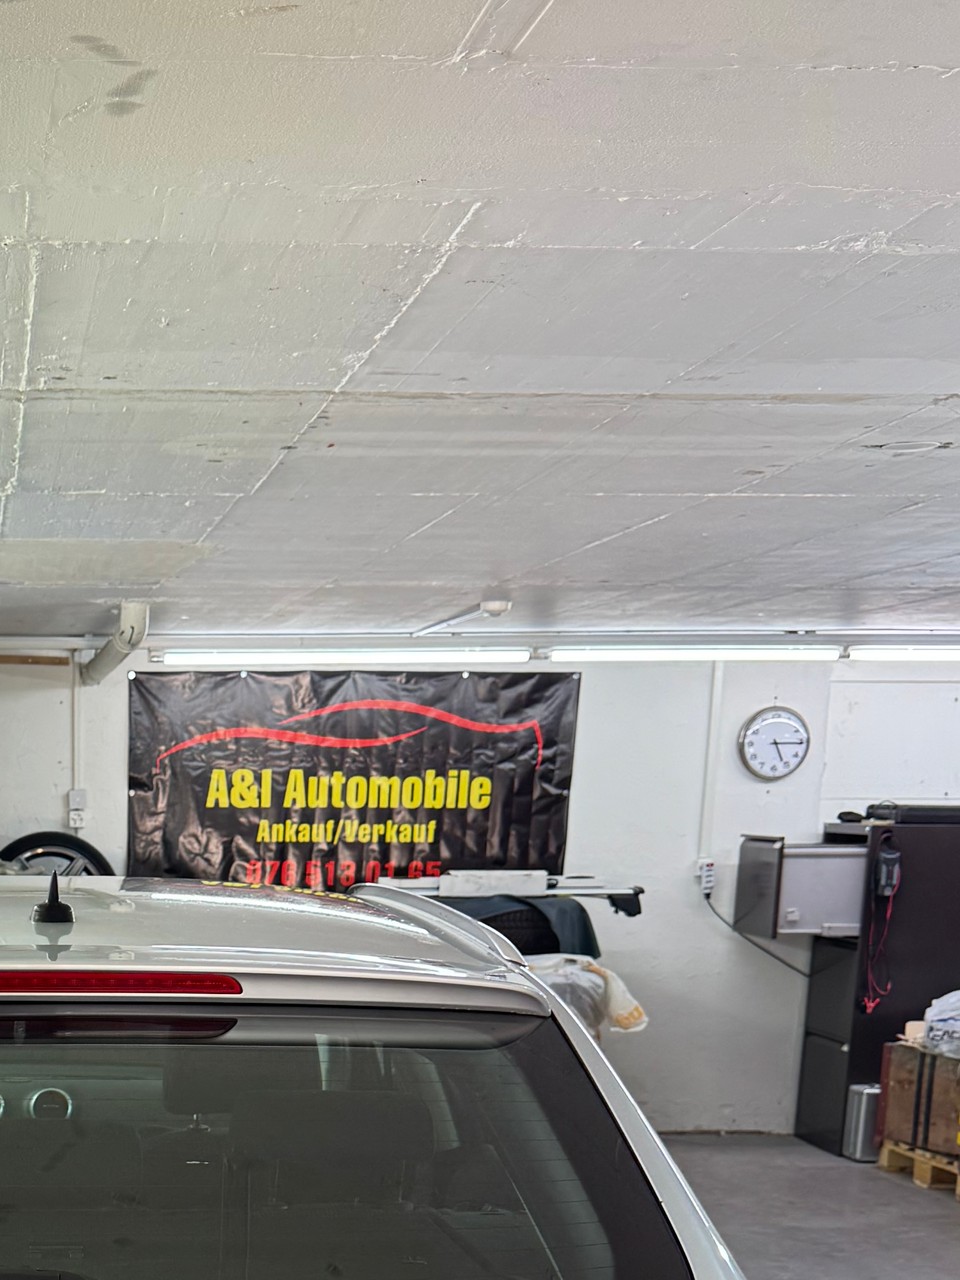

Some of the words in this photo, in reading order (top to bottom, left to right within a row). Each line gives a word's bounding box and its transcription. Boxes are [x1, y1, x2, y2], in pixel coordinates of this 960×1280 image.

[205, 768, 273, 809] A&I
[283, 769, 493, 810] Automobile
[256, 819, 438, 846] Ankauf/Verkauf
[245, 859, 297, 887] 076
[305, 860, 357, 887] 513
[365, 860, 395, 884] 01
[407, 860, 442, 879] 65
